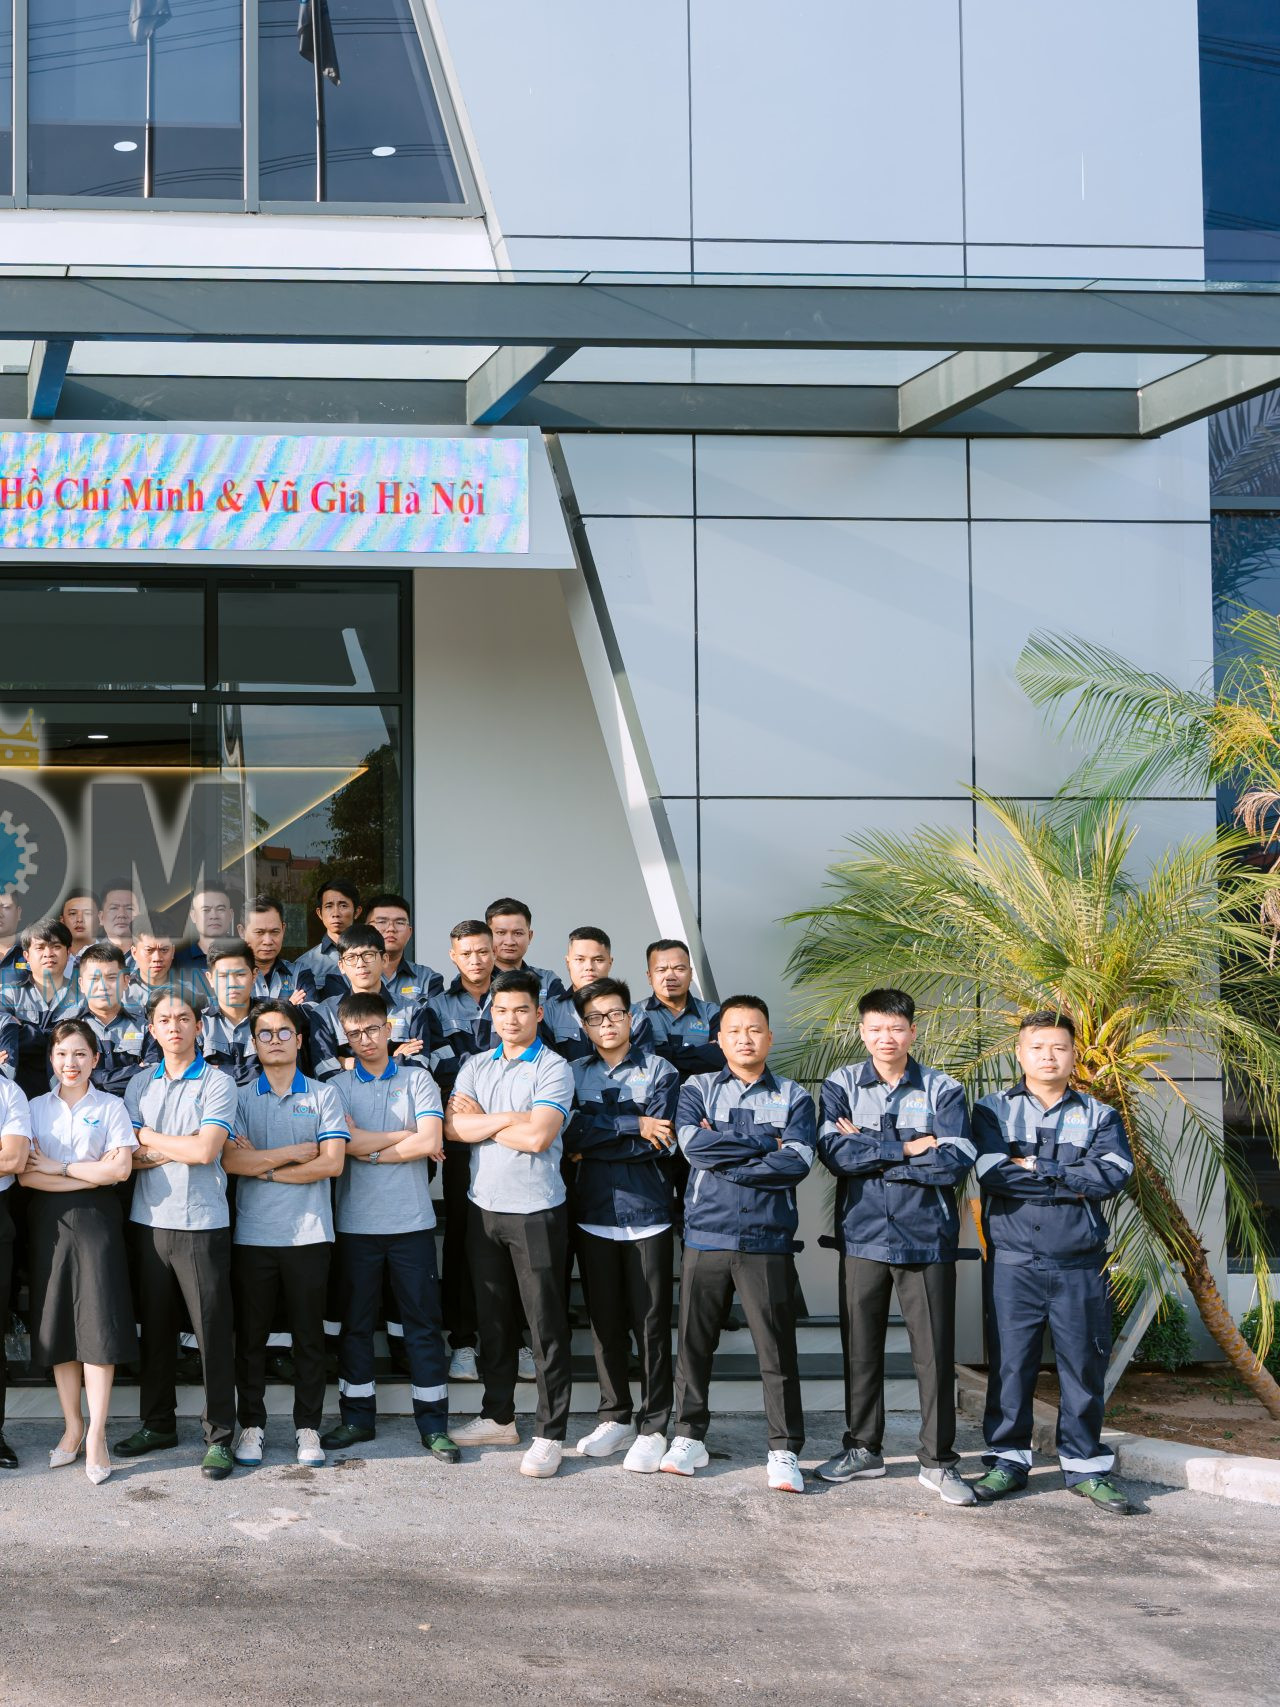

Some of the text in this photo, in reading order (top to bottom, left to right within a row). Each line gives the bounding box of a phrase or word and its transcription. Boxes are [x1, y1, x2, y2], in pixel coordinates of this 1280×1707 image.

[55, 478, 112, 511] Chí
[120, 477, 205, 512] Minh
[215, 479, 243, 513] &
[253, 479, 301, 514] Vũ
[310, 480, 366, 514] Gia
[376, 481, 421, 515] Hà
[431, 480, 486, 523] Nội
[293, 1105, 316, 1114] KOM
